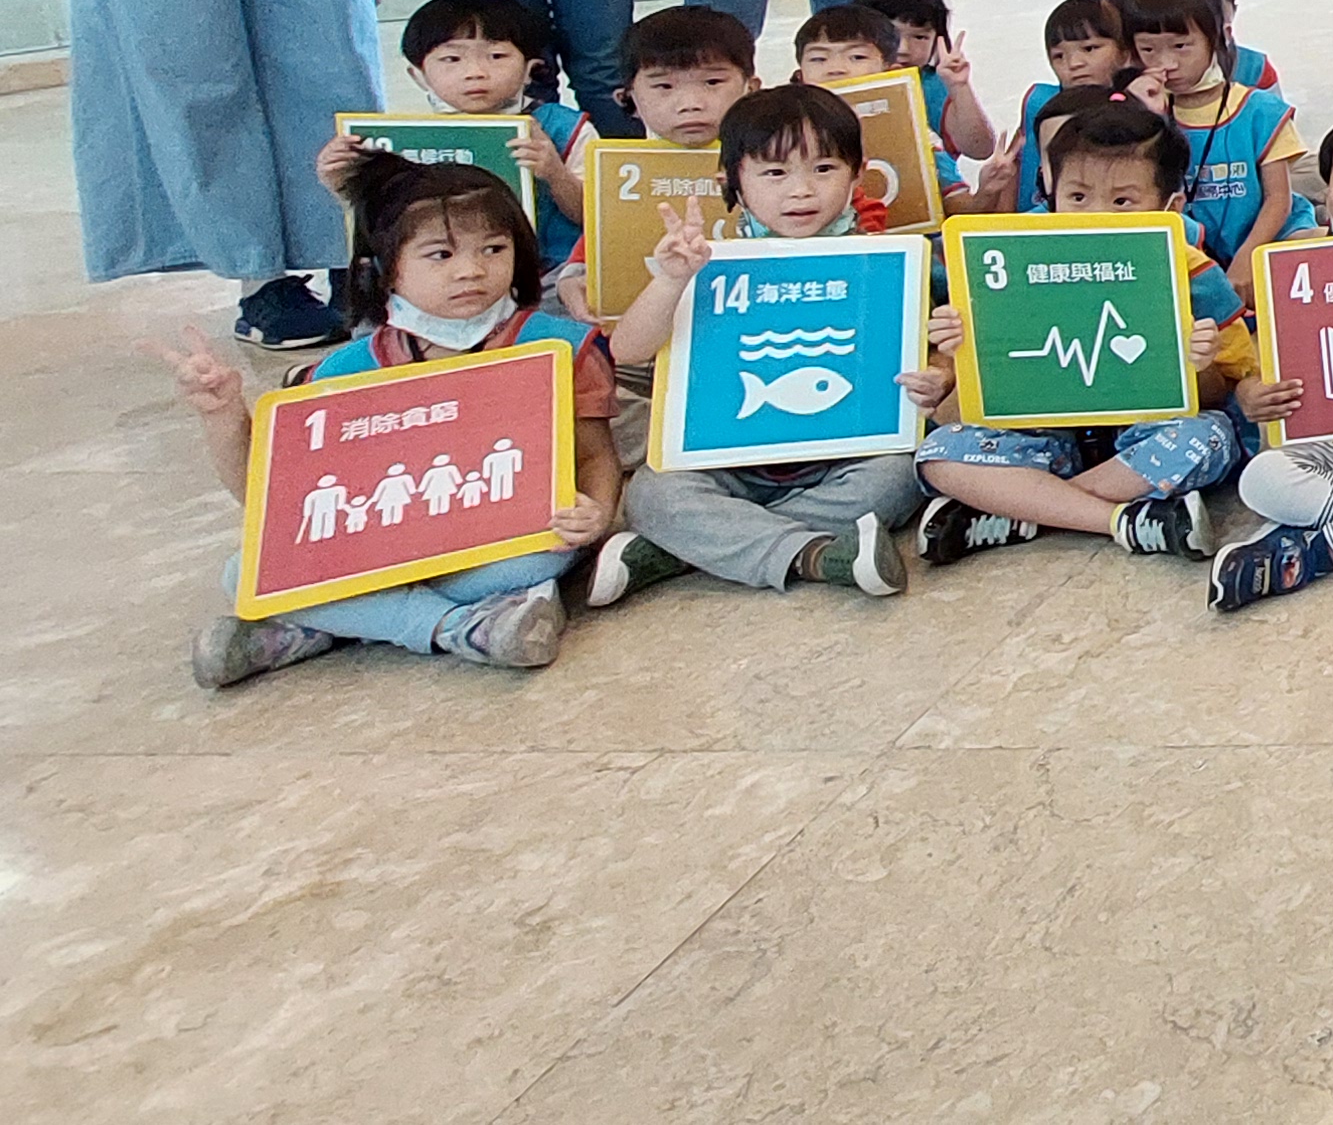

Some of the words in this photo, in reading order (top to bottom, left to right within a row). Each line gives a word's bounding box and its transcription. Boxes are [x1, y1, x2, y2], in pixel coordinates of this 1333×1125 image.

[619, 163, 640, 200] 2
[983, 249, 1008, 289] 3
[1026, 261, 1138, 284] 健康與福祉
[1290, 262, 1314, 303] 4
[711, 274, 750, 315] 14
[756, 280, 849, 304] 海洋生態
[304, 409, 328, 451] 1
[339, 400, 460, 443] 消除貧窮
